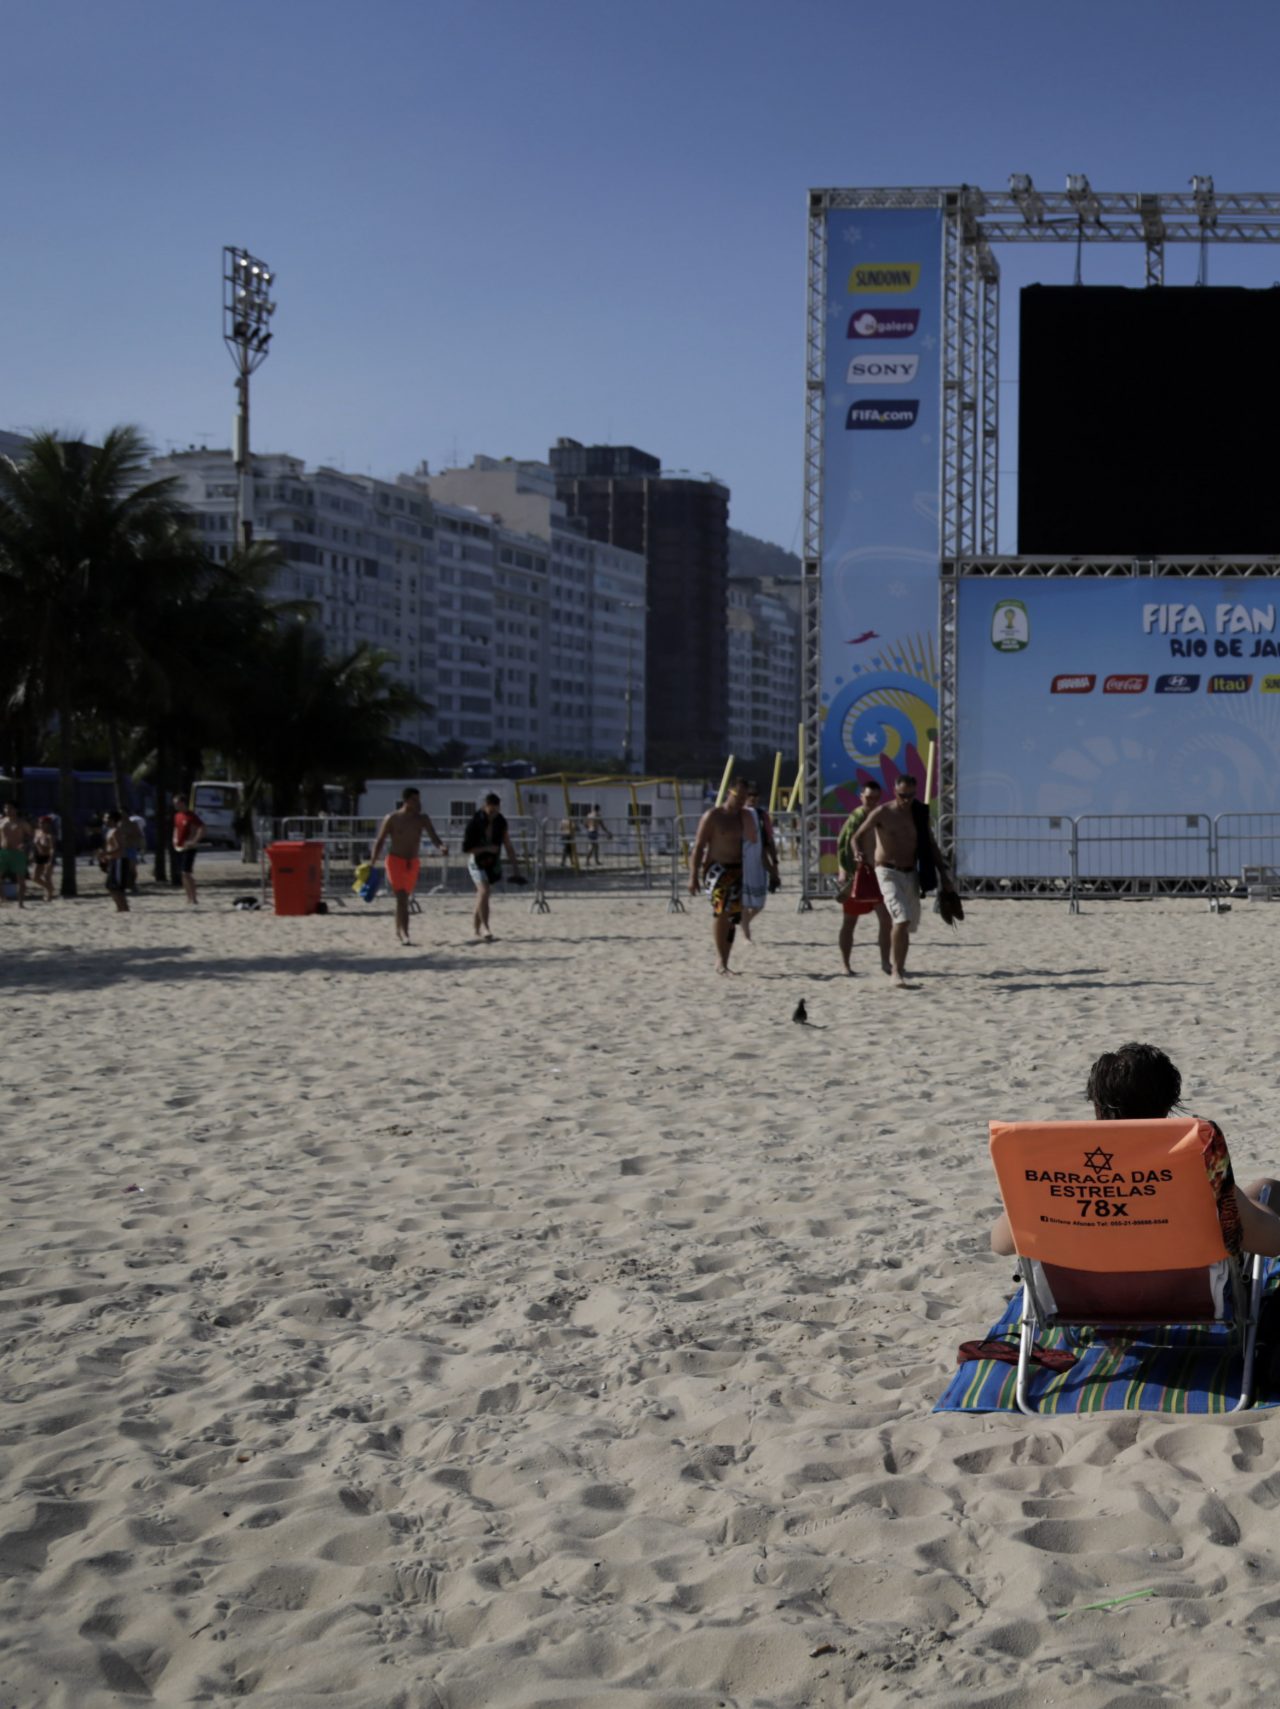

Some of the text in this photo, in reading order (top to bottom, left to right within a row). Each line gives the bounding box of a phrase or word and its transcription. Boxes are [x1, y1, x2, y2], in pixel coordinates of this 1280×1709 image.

[855, 269, 912, 287] SUNDOWN
[878, 321, 914, 333] galera
[852, 363, 915, 376] SONY
[852, 408, 913, 421] FIFA.com
[1143, 603, 1207, 635] FIFA
[1215, 603, 1276, 635] FAN
[1170, 638, 1208, 658] RIO
[1214, 638, 1243, 658] DE
[1213, 676, 1246, 691] Itaú
[1025, 1168, 1173, 1184] BARRACA DAS
[1050, 1184, 1157, 1198] ESTRELAS
